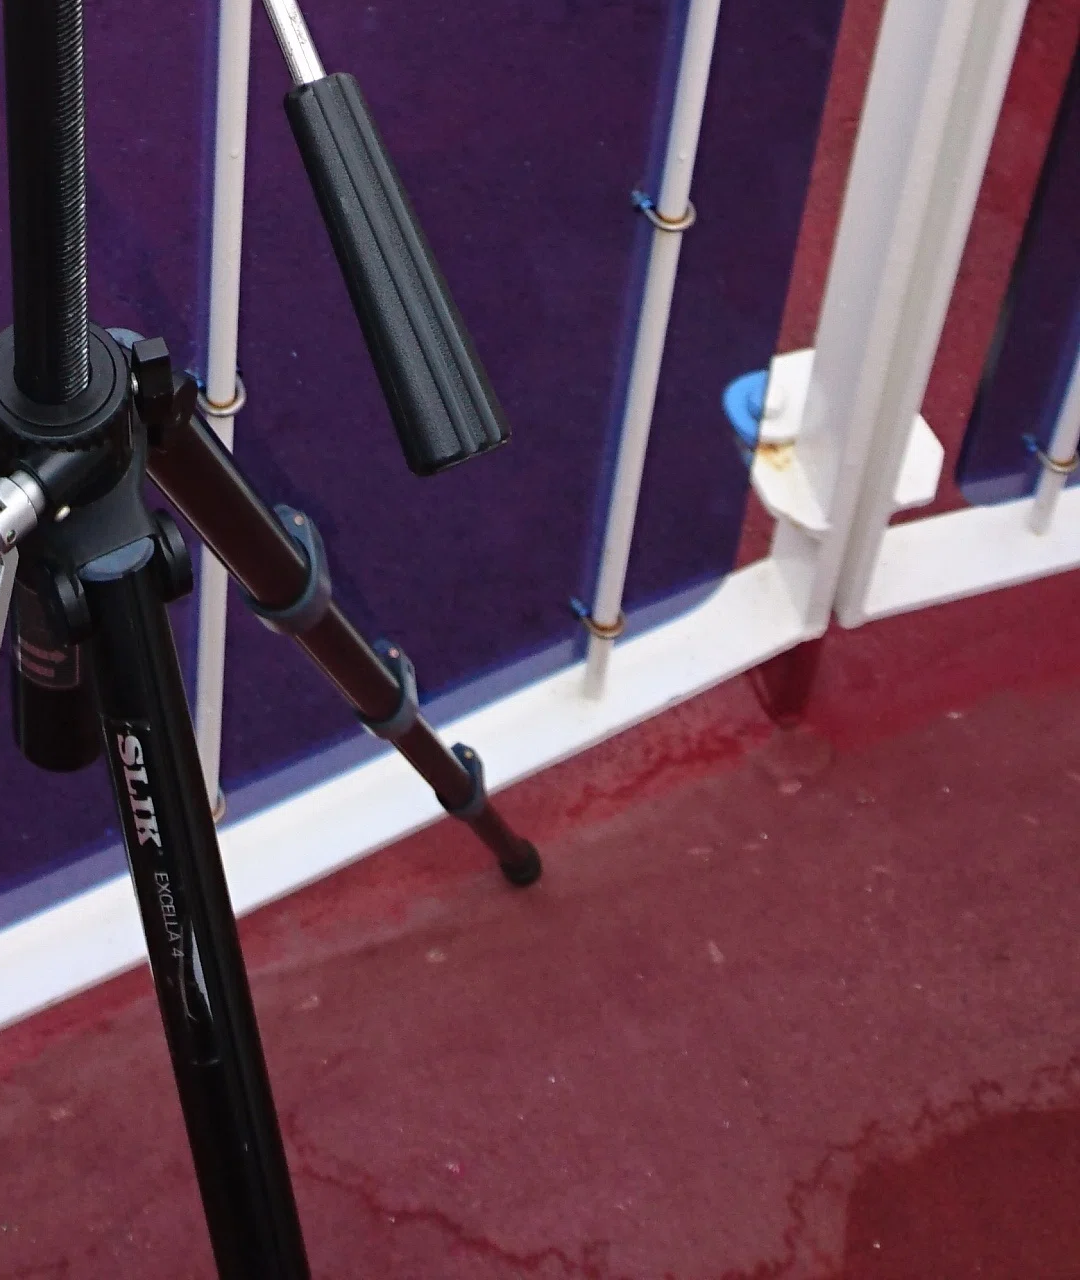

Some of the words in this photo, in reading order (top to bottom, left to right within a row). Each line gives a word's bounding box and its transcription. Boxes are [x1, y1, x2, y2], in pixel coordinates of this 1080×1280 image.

[117, 733, 163, 848] SLIK
[154, 871, 181, 943] EXCELLA
[170, 947, 185, 959] 4
